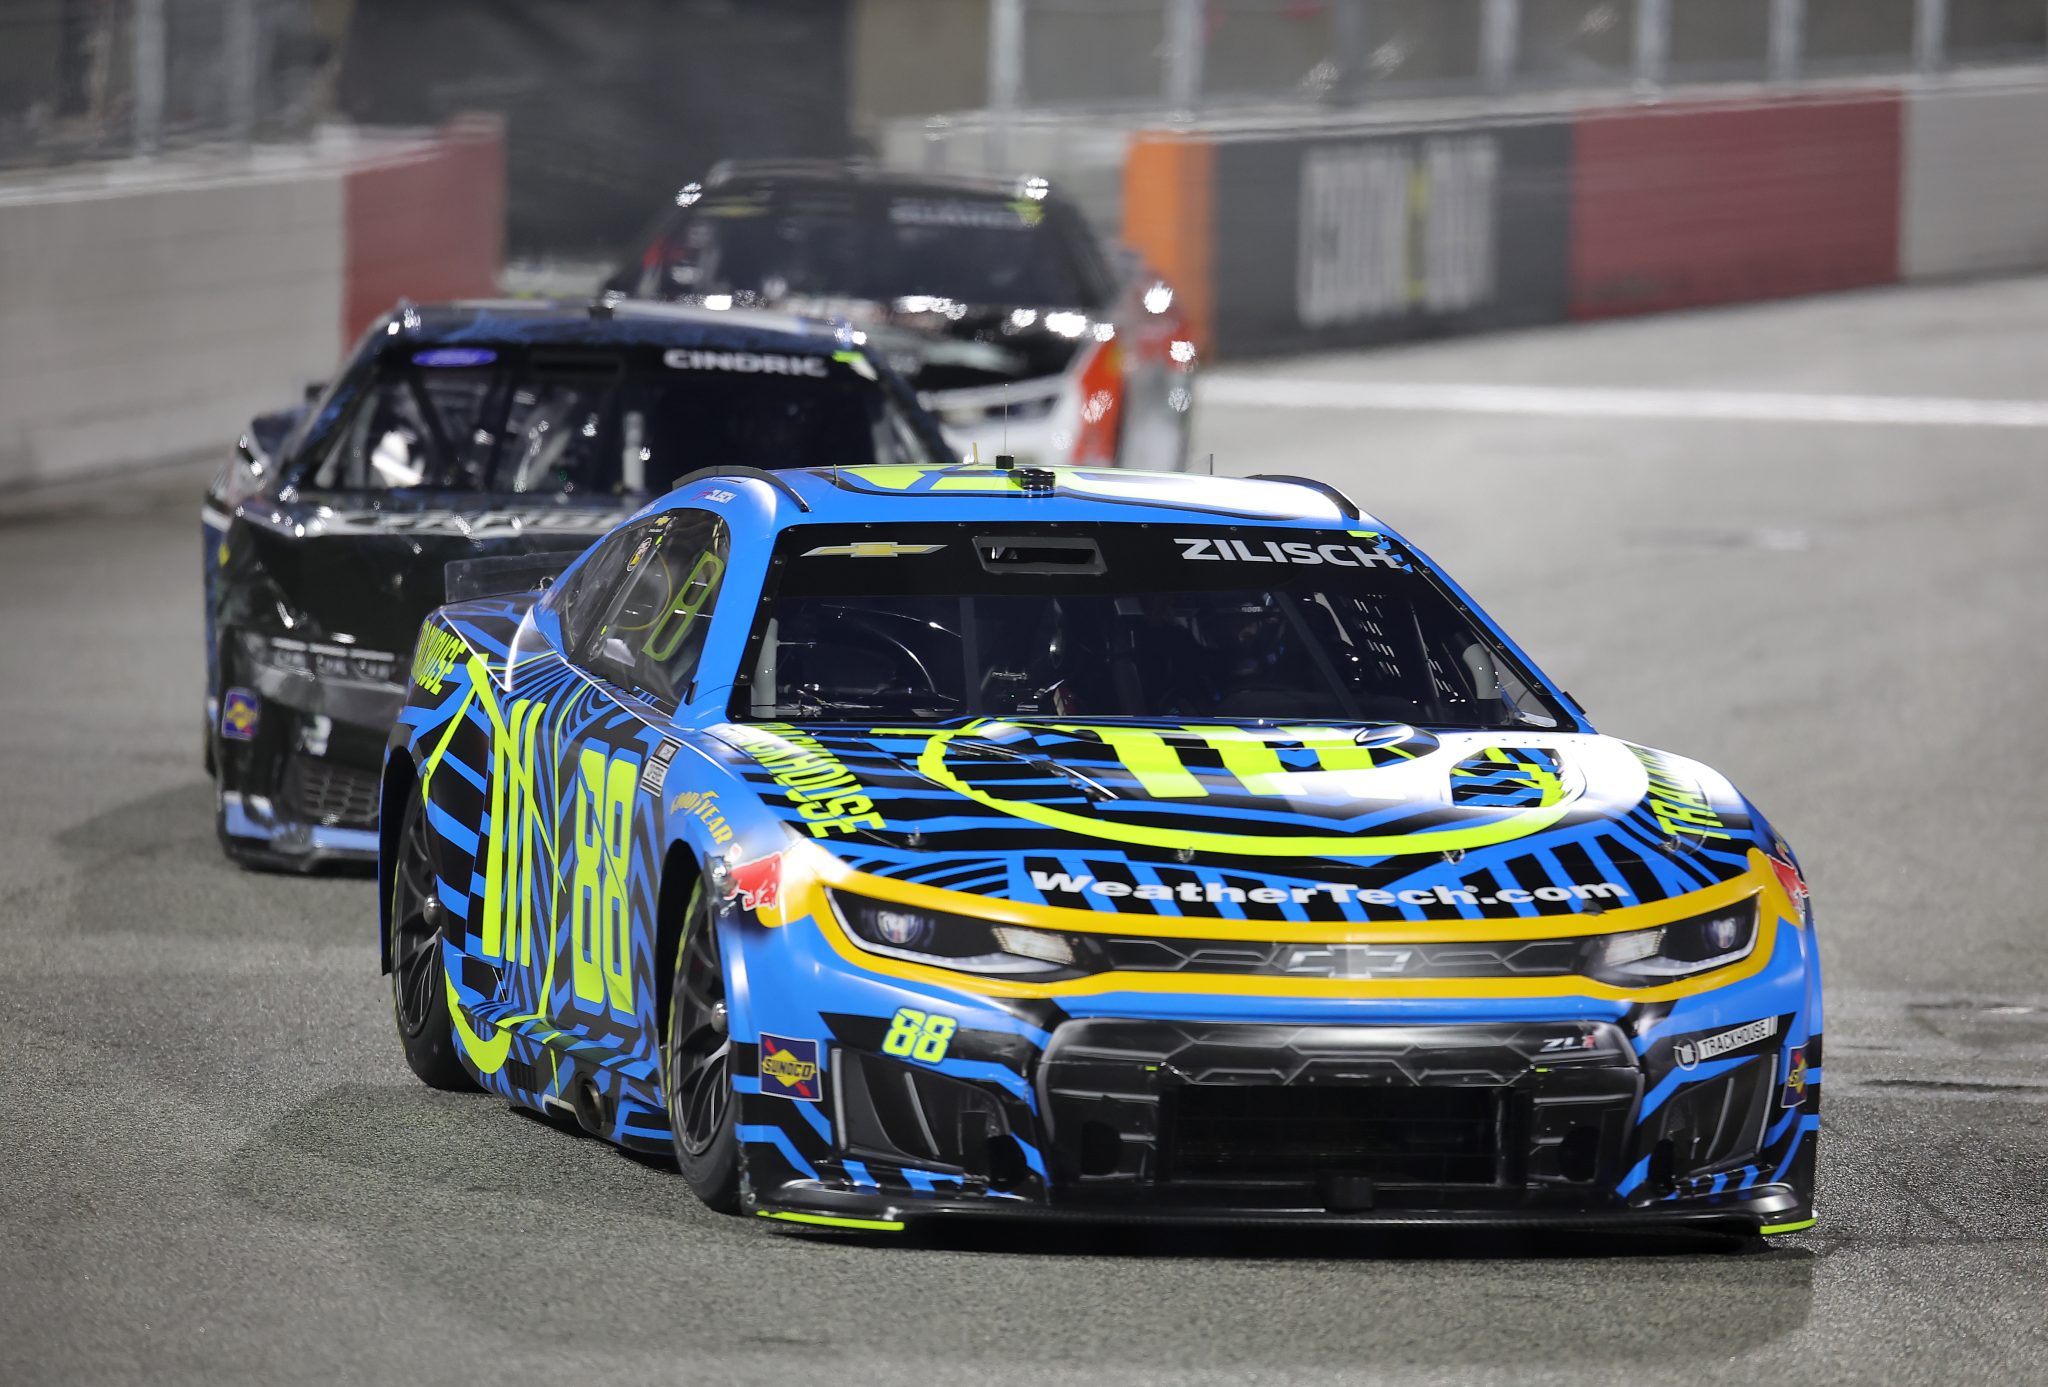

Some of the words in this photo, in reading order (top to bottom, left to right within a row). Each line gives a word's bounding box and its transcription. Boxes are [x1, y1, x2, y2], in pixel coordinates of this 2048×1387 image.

[664, 349, 828, 378] CINDRIC
[1173, 538, 1401, 569] ZILISCH
[738, 721, 887, 839] RACKHOUSE
[572, 748, 638, 1016] 88
[881, 1006, 958, 1064] 88
[1701, 1021, 1767, 1057] TRACKHOUSE
[763, 1057, 814, 1079] SUNOCO
